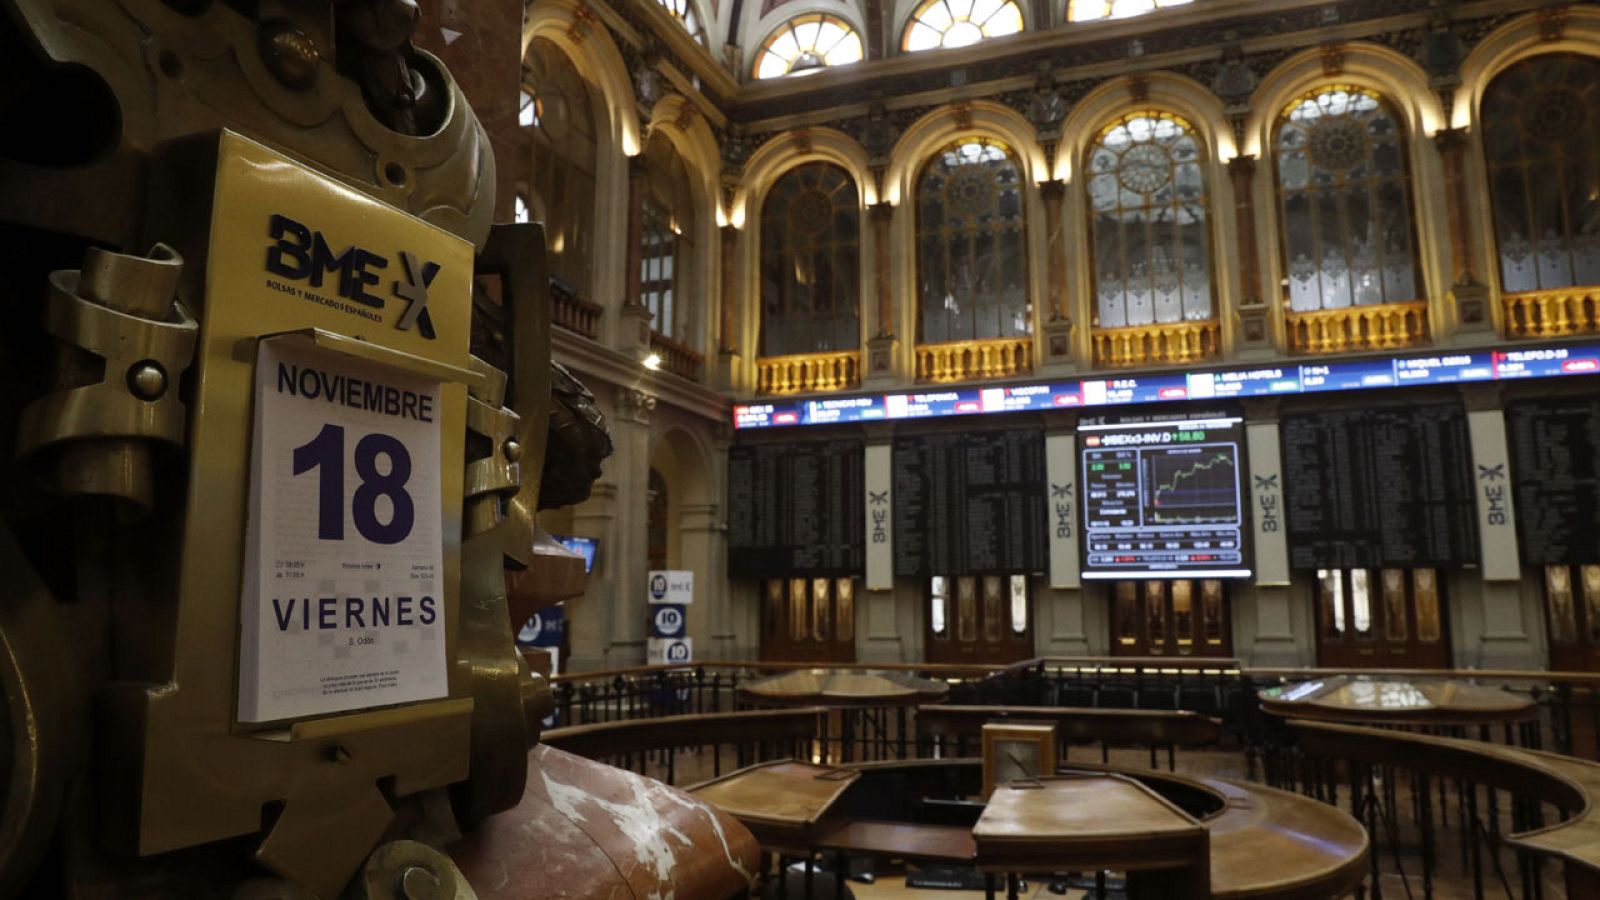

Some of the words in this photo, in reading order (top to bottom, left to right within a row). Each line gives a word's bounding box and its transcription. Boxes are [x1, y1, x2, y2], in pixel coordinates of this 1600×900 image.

[267, 280, 296, 296] BOLSAS
[296, 290, 303, 298] Y
[304, 292, 345, 311] MERCADOS
[345, 304, 383, 323] ESPAÑOLES
[277, 362, 433, 423] NOVIEMBRE
[293, 423, 415, 545] 18
[272, 596, 436, 631] VIERNES
[661, 612, 678, 623] 10
[671, 645, 686, 659] 10
